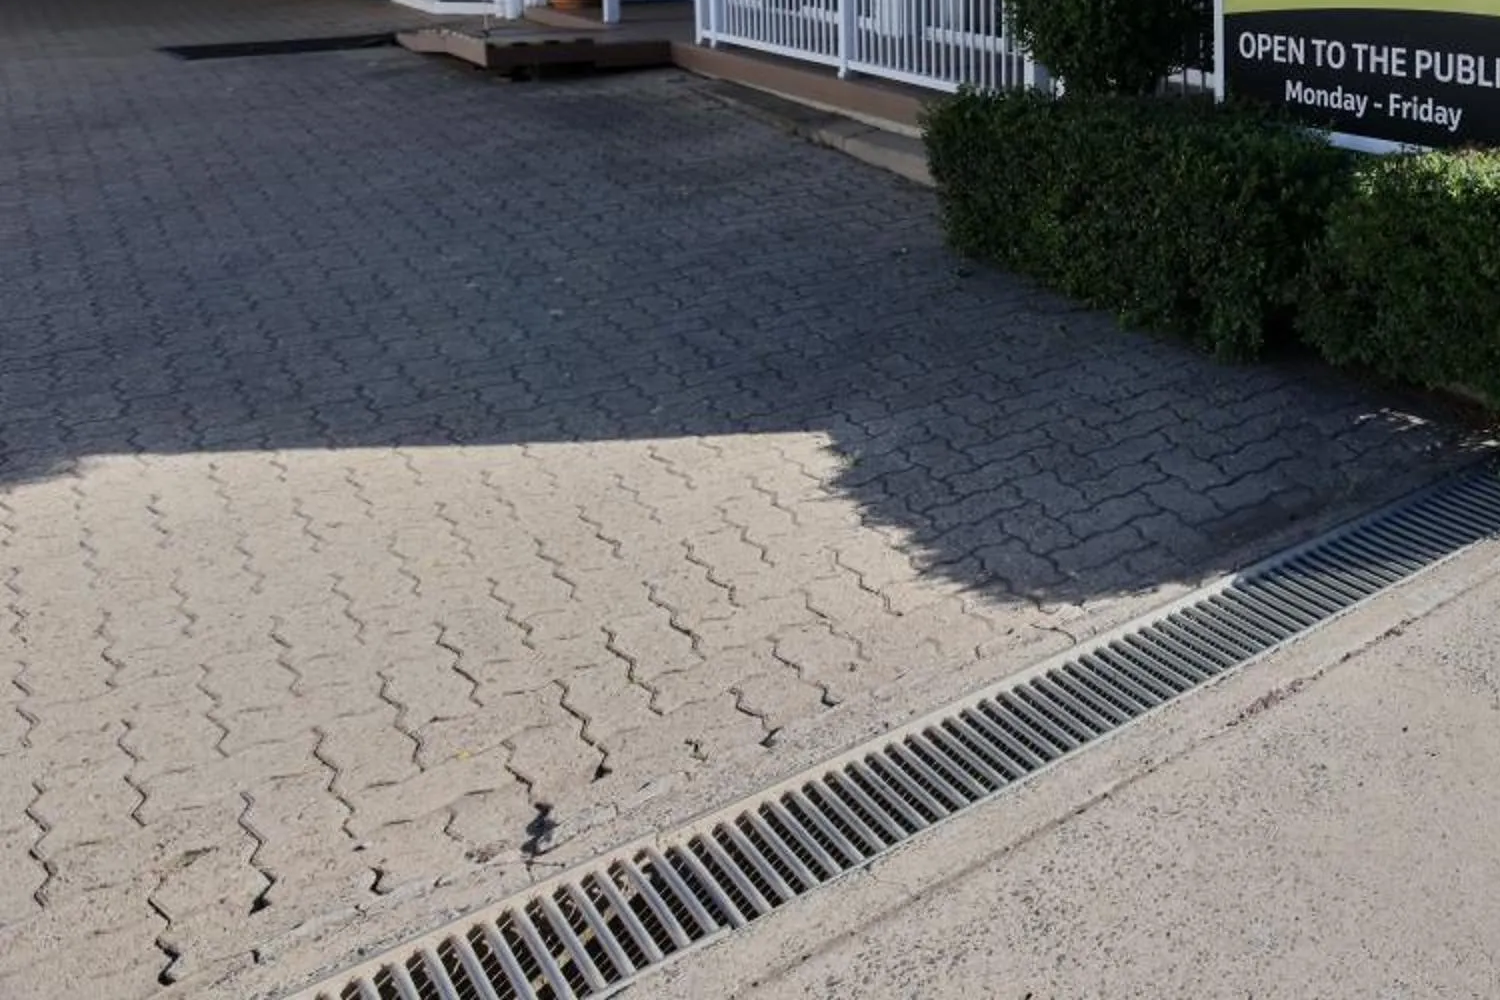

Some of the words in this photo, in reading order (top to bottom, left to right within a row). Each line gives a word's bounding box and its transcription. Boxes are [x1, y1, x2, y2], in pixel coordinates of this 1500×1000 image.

[1238, 31, 1305, 65] OPEN
[1311, 39, 1346, 70] TO
[1352, 43, 1407, 78] THE
[1285, 79, 1369, 119] Monday
[1389, 92, 1463, 132] Friday
